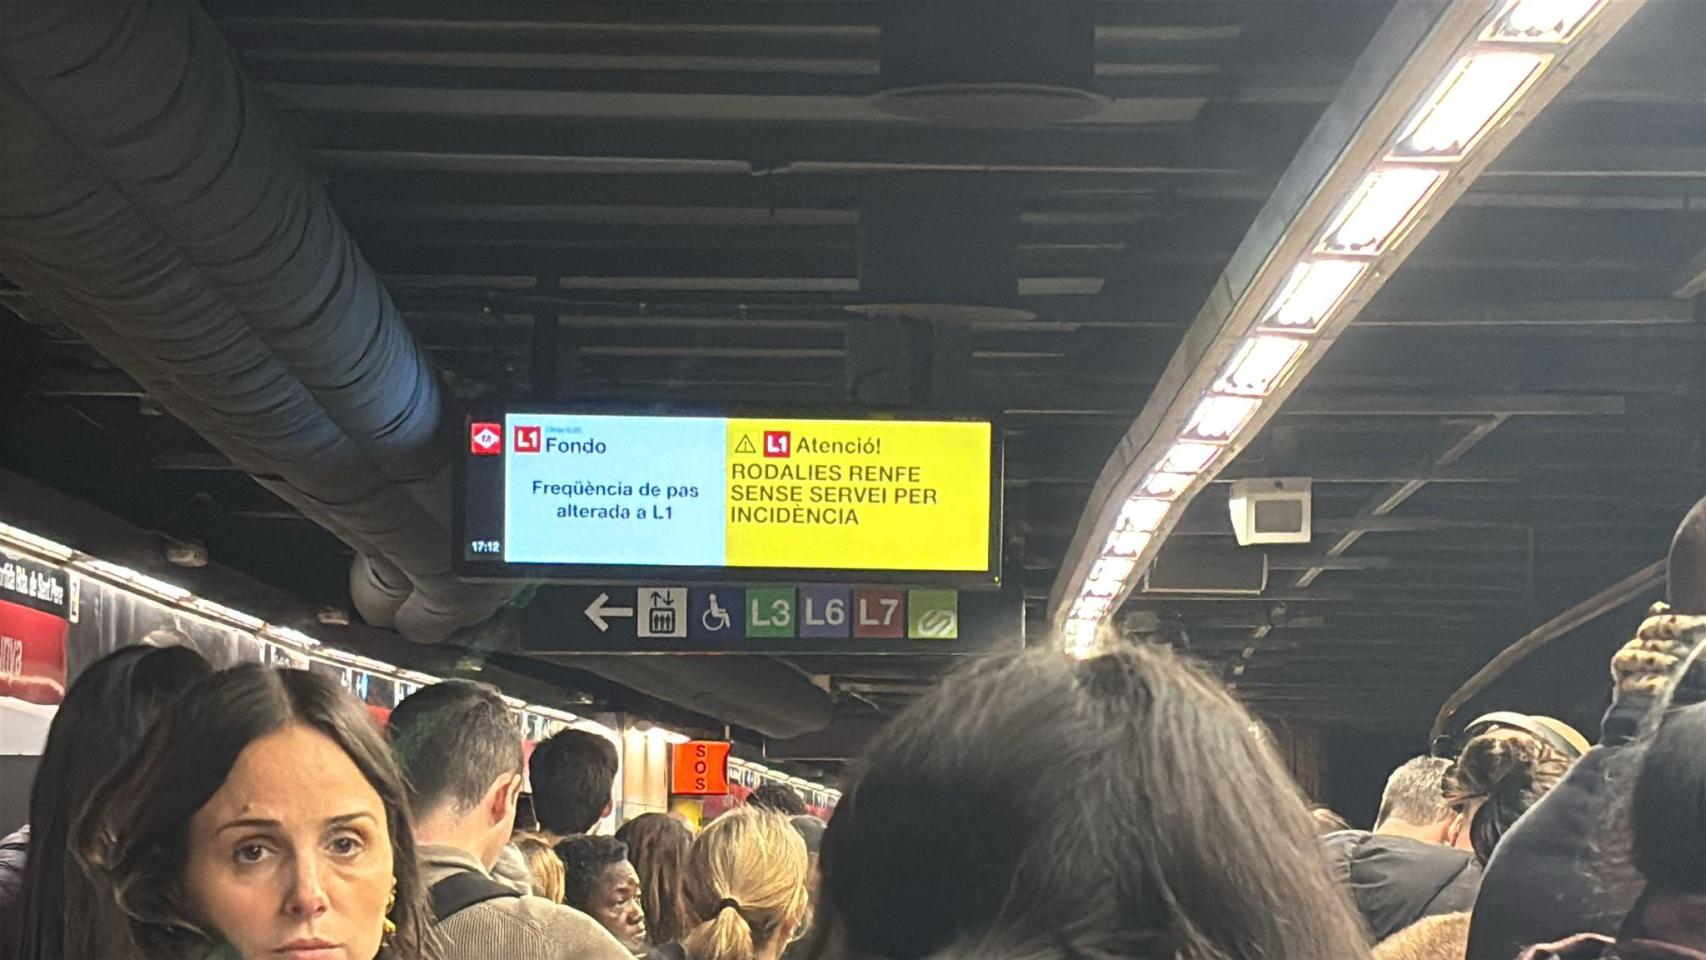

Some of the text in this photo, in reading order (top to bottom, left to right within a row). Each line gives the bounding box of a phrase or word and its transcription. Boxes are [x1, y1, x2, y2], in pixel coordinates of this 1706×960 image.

[517, 429, 538, 448] L1
[545, 437, 608, 455] Fondo
[766, 434, 882, 455] L1 Atenció!
[731, 463, 921, 483] RODALIES RENFE
[531, 480, 700, 499] Freqüència de pas
[730, 485, 938, 505] SENSE SERVEI PER
[556, 503, 673, 520] alterada a L1
[731, 504, 860, 525] INCIDÈNCIA
[471, 541, 501, 553] 17:12
[751, 597, 899, 627] L3 L6 L7
[694, 743, 707, 791] SOS
